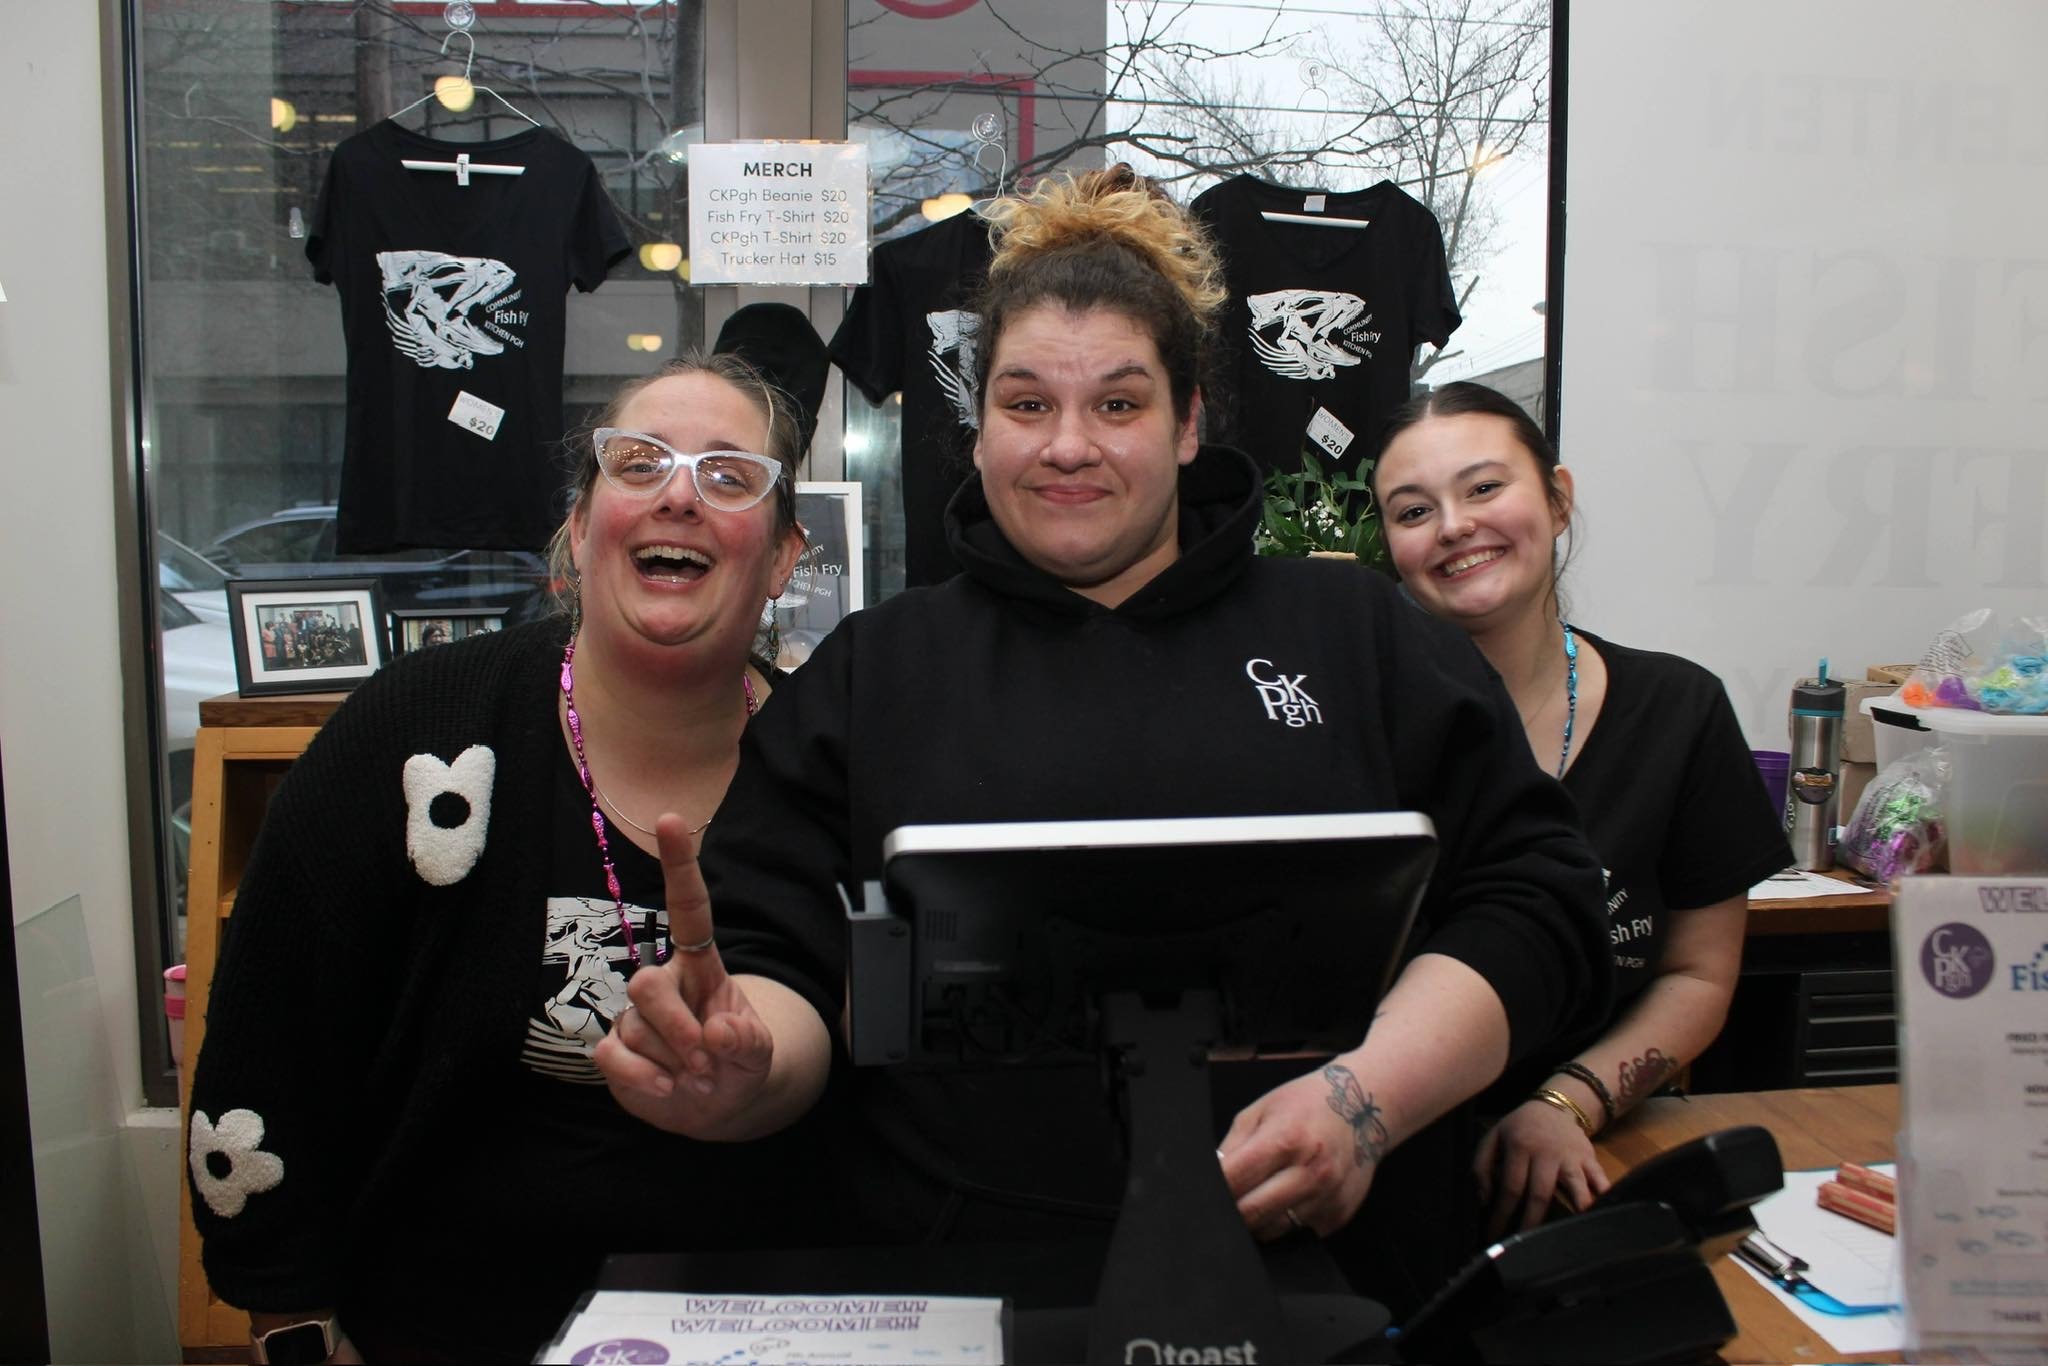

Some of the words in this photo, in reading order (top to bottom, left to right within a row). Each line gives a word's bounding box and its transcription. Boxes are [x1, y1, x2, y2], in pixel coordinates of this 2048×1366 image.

[743, 162, 813, 178] MERCH
[709, 189, 757, 204] CKPgh
[762, 189, 813, 202] Beanie
[821, 189, 847, 202] $20
[707, 210, 735, 223] Fish
[740, 211, 762, 226] Fry
[766, 210, 815, 223] T-Shirt
[823, 211, 849, 224] $20
[710, 231, 758, 247] CKPgh
[764, 231, 812, 244] T-Shirt
[820, 232, 846, 245] $20
[721, 252, 775, 265] Trucker
[780, 252, 805, 265] Hat
[814, 253, 837, 266] $15
[494, 309, 517, 324] Fish
[1351, 331, 1369, 342] Fish
[469, 417, 494, 435] $20
[1321, 434, 1343, 454] $20
[822, 563, 843, 577] Fry
[1631, 915, 1653, 938] Fry
[1163, 1340, 1258, 1366] toast
